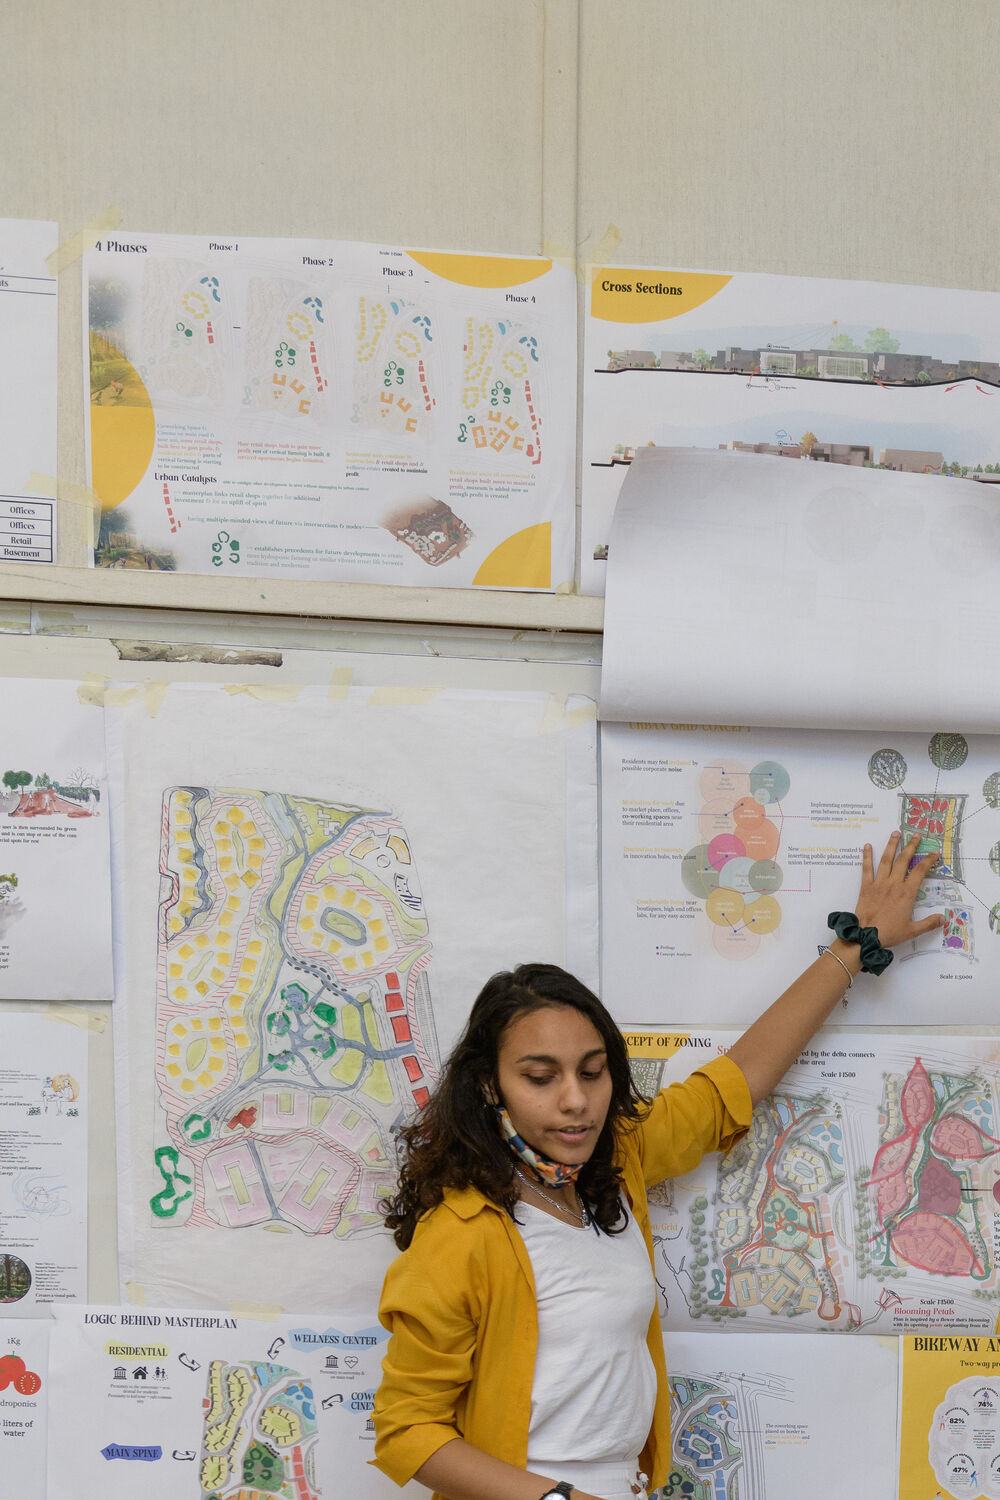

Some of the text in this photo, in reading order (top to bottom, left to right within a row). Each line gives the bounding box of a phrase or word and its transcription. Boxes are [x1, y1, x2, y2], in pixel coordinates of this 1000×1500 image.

[95, 240, 148, 253] 4 Phases
[209, 243, 239, 251] Phase 1
[302, 256, 334, 266] Phase 2
[382, 267, 413, 278] Phase 3
[601, 280, 683, 296] Cross Sections
[505, 293, 537, 303] Phase 4
[154, 472, 217, 485] Urban Catalysts
[9, 506, 35, 516] Offices
[9, 521, 35, 531] Offices
[10, 536, 32, 546] Retail
[3, 548, 40, 558] Basement
[624, 1036, 712, 1048] CEPT OF ZONING
[811, 1050, 819, 1058] by
[894, 1308, 955, 1316] Blooming Petals
[84, 1314, 238, 1329] LOGIC BEHIND MASTERPLAN
[7, 1338, 20, 1346] 1Kg
[294, 1334, 377, 1346] WELLNESS CENTER
[914, 1338, 980, 1352] BIKEWAY
[109, 1346, 168, 1357] RESIDENTIAL
[960, 1360, 990, 1369] Two-way
[2, 1420, 34, 1428] liters of
[106, 1448, 159, 1458] MAIN SPINE
